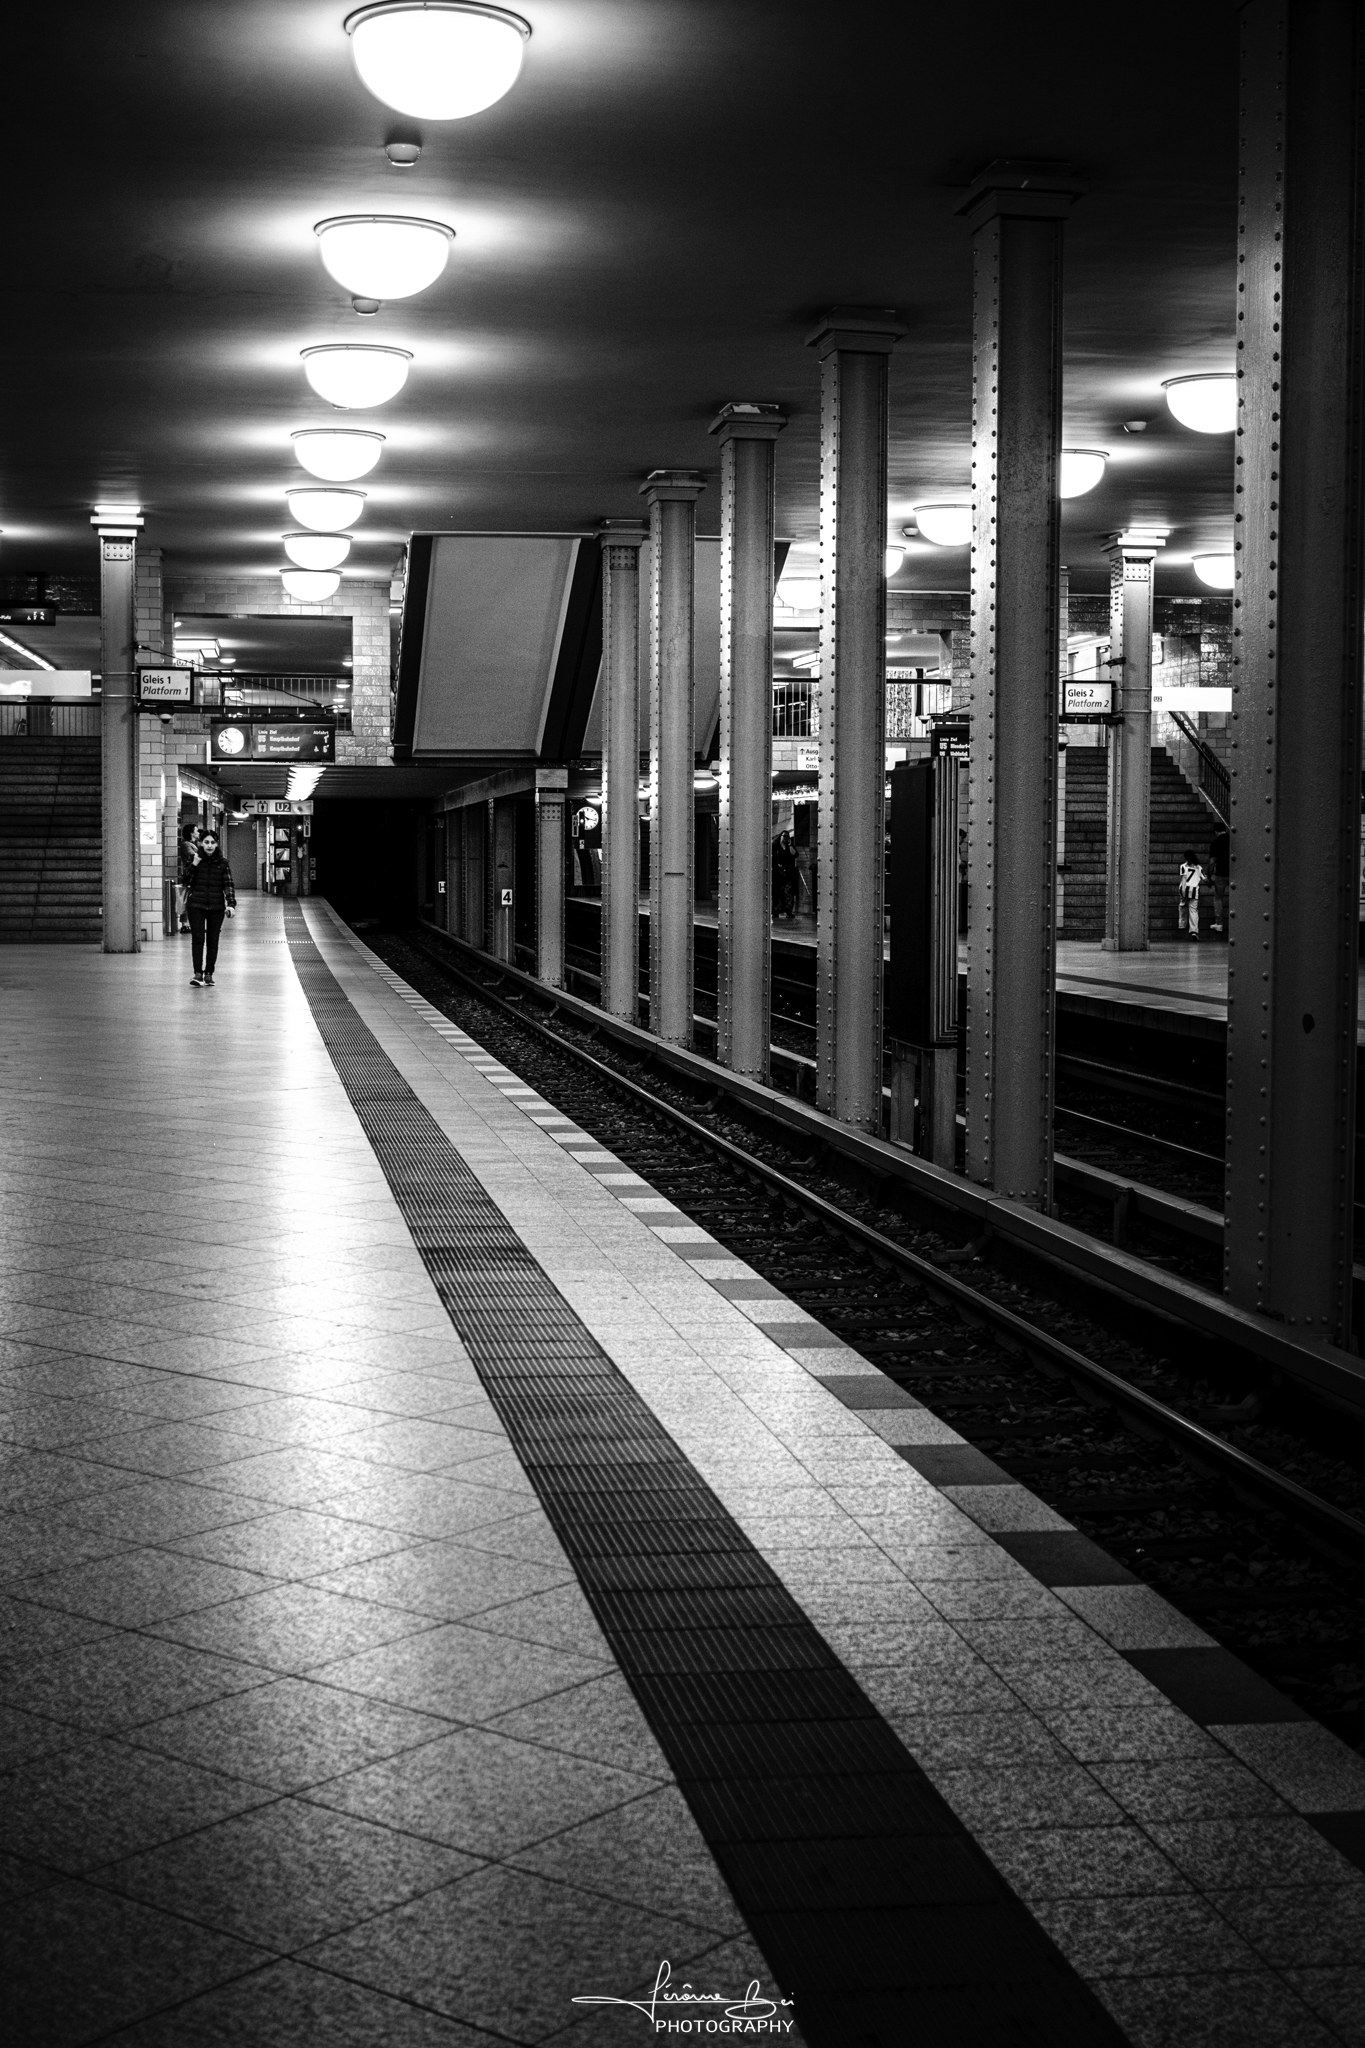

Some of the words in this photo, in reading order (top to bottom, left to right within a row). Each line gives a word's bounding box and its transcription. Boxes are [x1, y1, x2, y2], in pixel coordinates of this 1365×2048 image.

[142, 675, 164, 684] Gleis
[167, 675, 171, 684] 1
[142, 686, 181, 695] Platform
[185, 687, 189, 695] 1
[1067, 689, 1087, 697] Gleis
[1089, 689, 1094, 697] 2
[1068, 699, 1102, 707] Platform
[276, 803, 290, 812] U2
[1187, 868, 1196, 882] 7
[503, 891, 511, 903] 4
